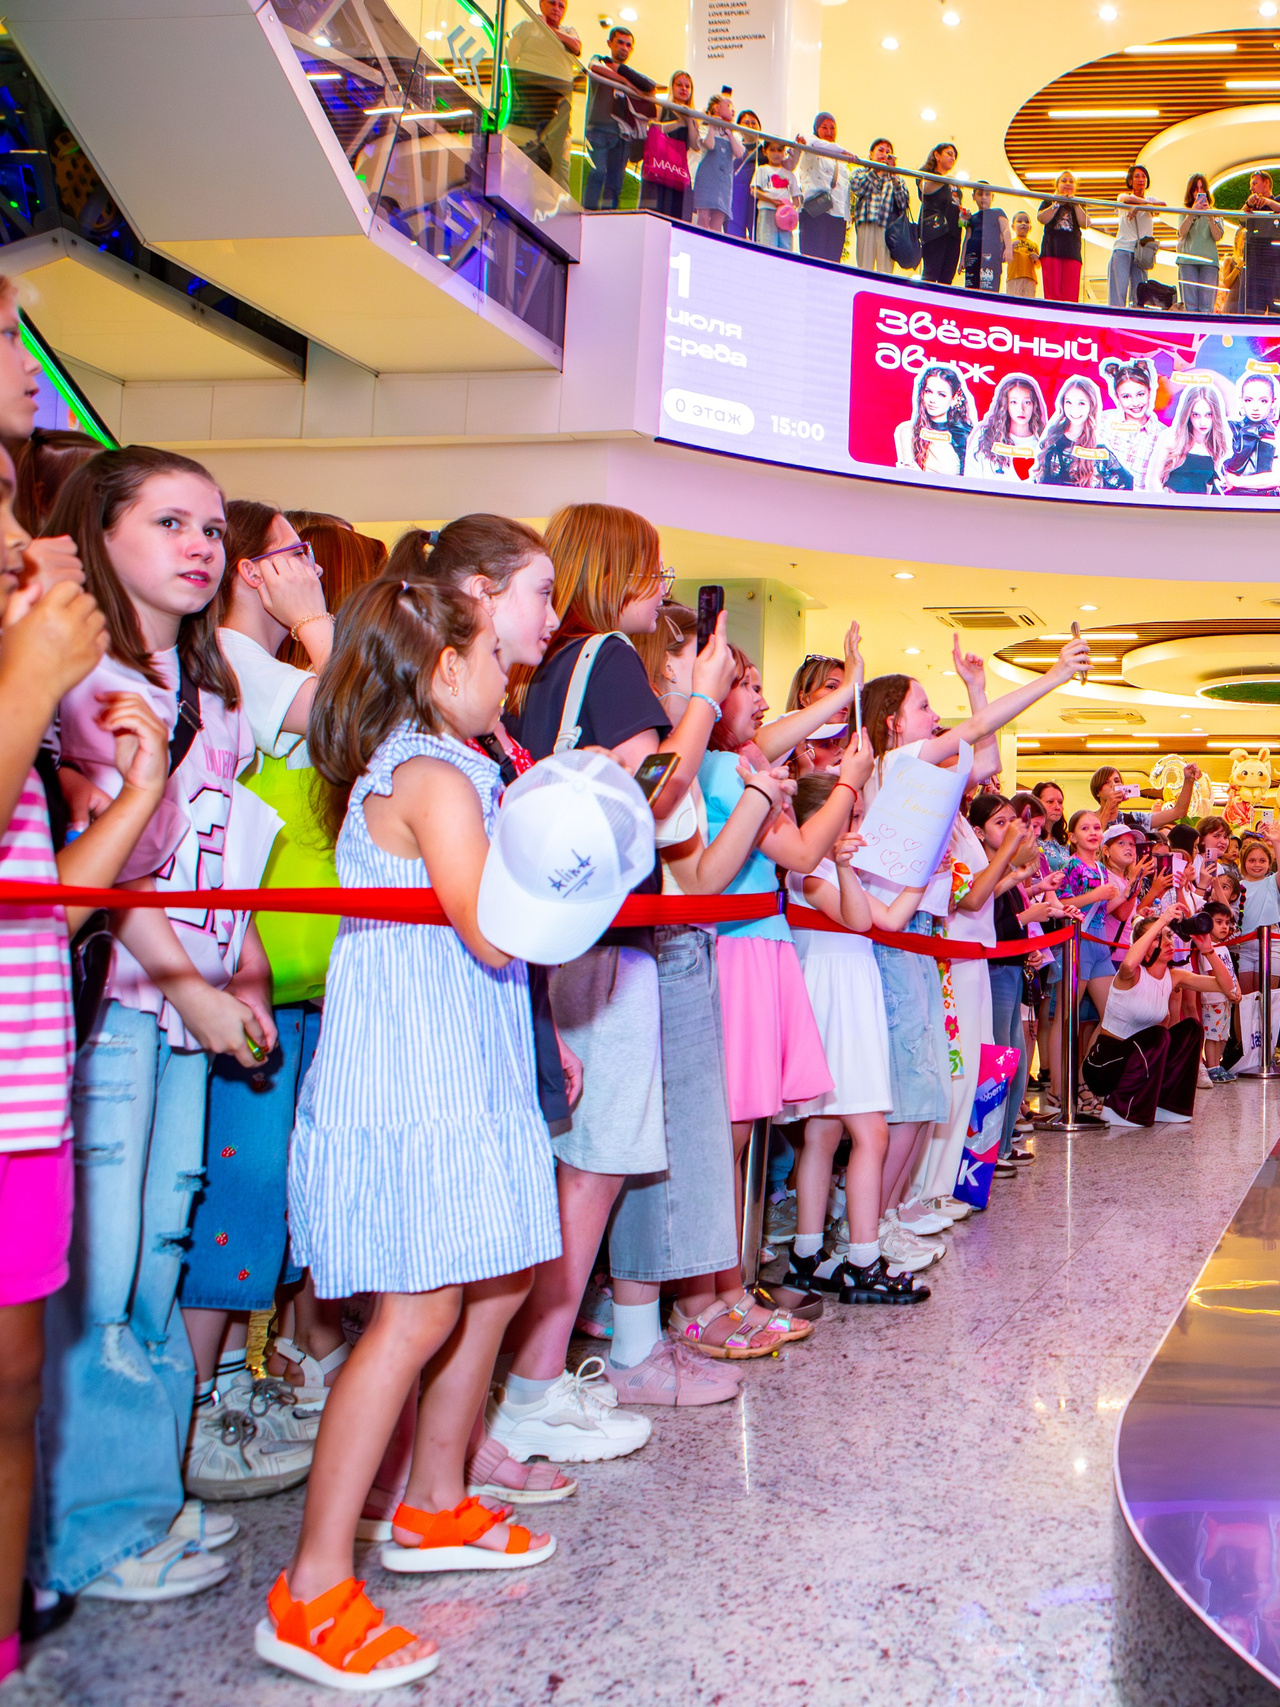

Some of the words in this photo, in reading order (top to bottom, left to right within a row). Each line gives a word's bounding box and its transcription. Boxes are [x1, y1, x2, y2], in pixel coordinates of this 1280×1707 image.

[653, 157, 688, 178] MAAG
[670, 252, 691, 298] 1
[666, 307, 743, 339] июля
[665, 335, 748, 368] среда
[692, 404, 742, 426] этаж
[771, 415, 825, 441] 15:00
